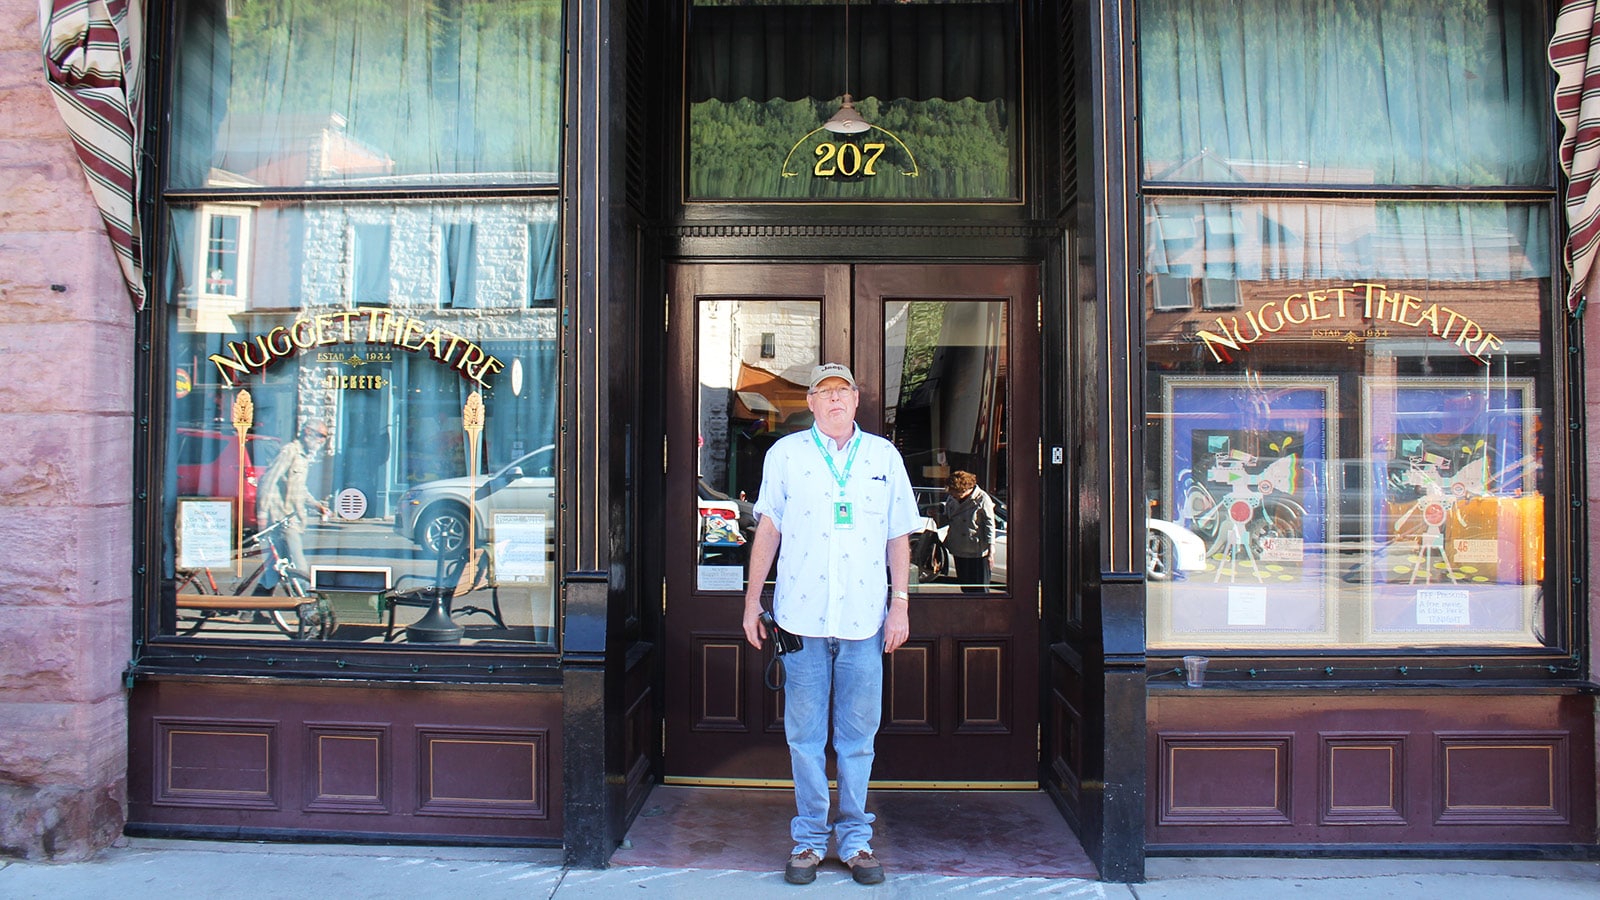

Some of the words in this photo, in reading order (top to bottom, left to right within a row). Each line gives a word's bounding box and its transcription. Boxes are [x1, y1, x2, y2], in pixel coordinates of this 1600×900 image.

[814, 143, 885, 176] 207
[1195, 288, 1355, 364] NUGGET
[1353, 282, 1504, 366] THEATRE
[1362, 328, 1389, 337] 1934
[208, 311, 361, 387] NUGGET
[358, 306, 505, 389] THEATRE
[366, 352, 391, 361] 1934
[327, 375, 382, 390] TICKETS
[1457, 541, 1469, 552] 46
